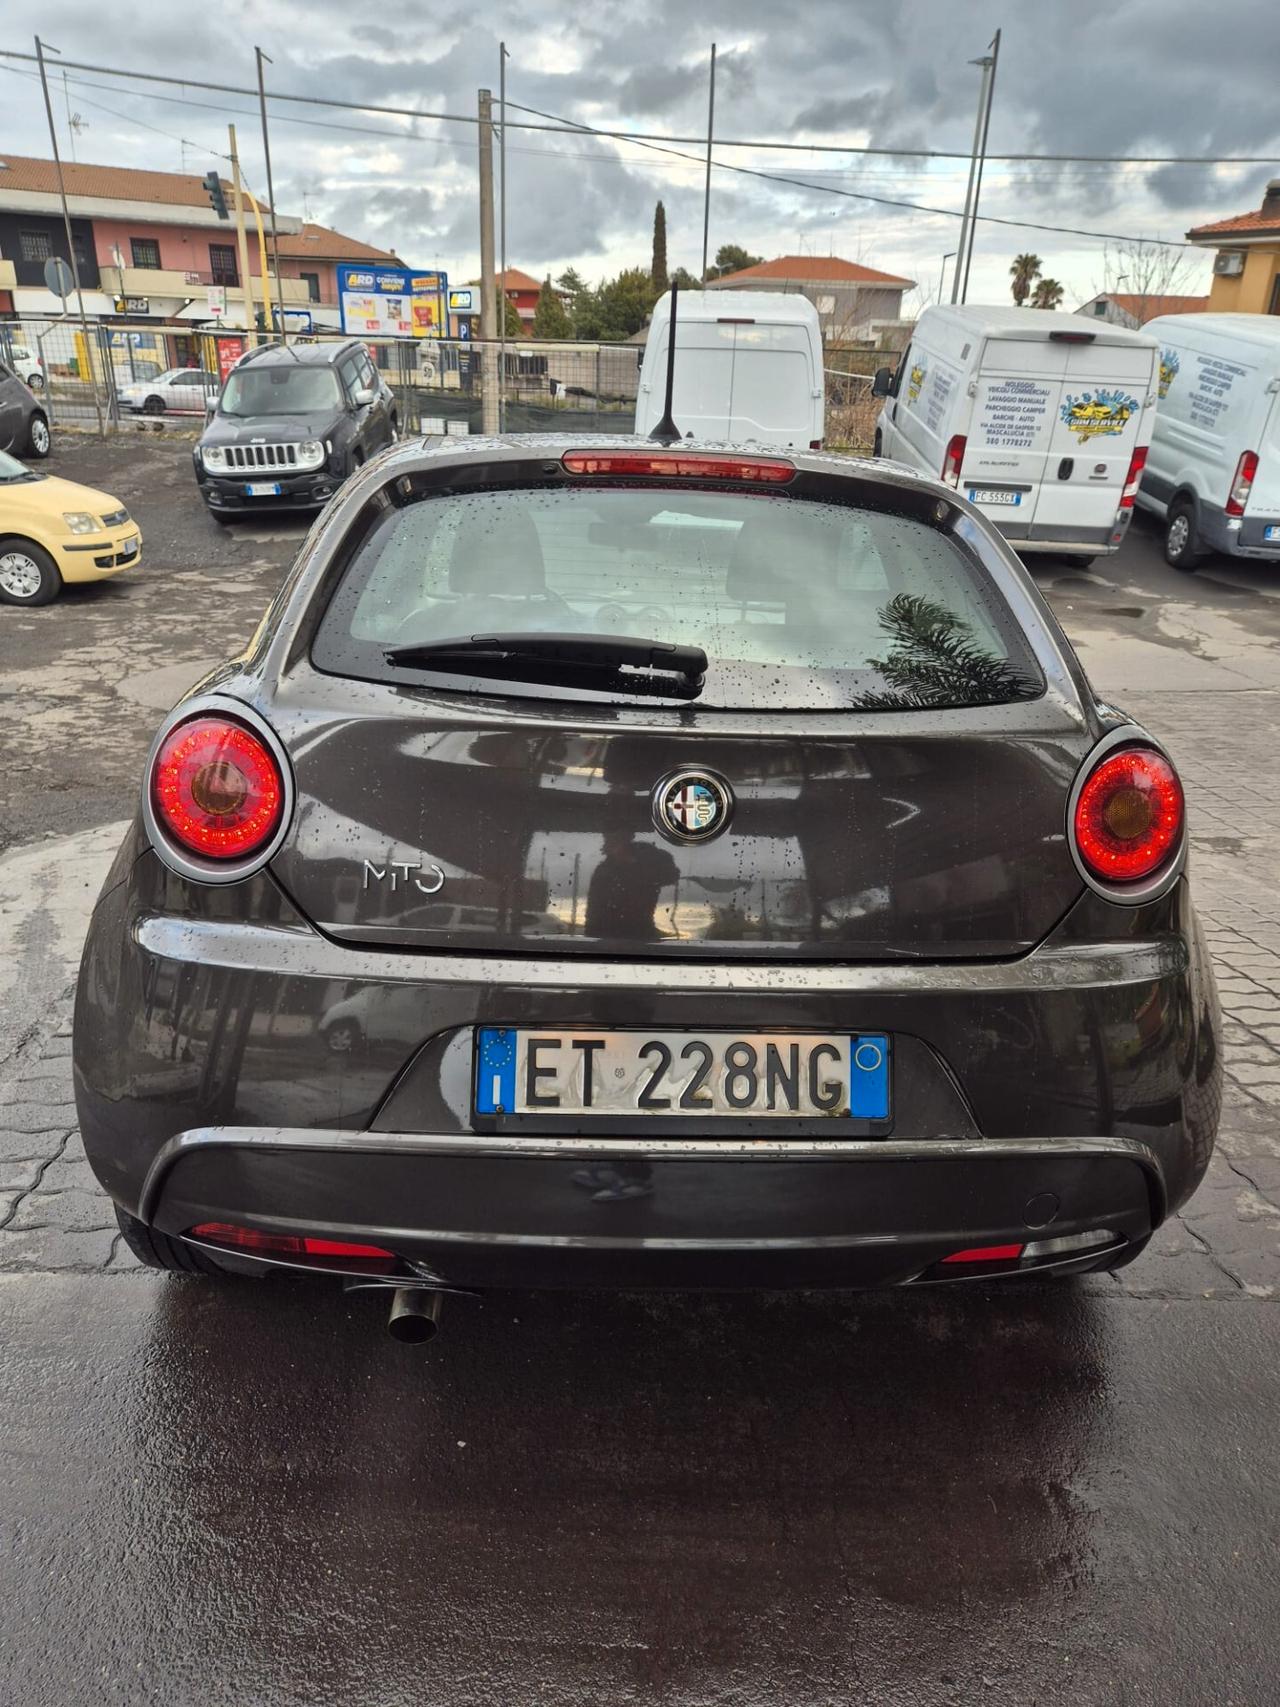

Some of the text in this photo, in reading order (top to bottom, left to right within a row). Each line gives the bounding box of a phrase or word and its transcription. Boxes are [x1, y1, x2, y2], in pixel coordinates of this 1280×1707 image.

[348, 274, 374, 286] ARD
[116, 300, 148, 311] ARD
[1005, 381, 1035, 389] NOLEGGIO
[988, 386, 1050, 396] VEICOLI COMMERCIALI
[985, 404, 1021, 412] PARCHEGGIO
[975, 491, 986, 501] FC
[526, 1038, 606, 1107] ET
[637, 1040, 842, 1111] 228NG
